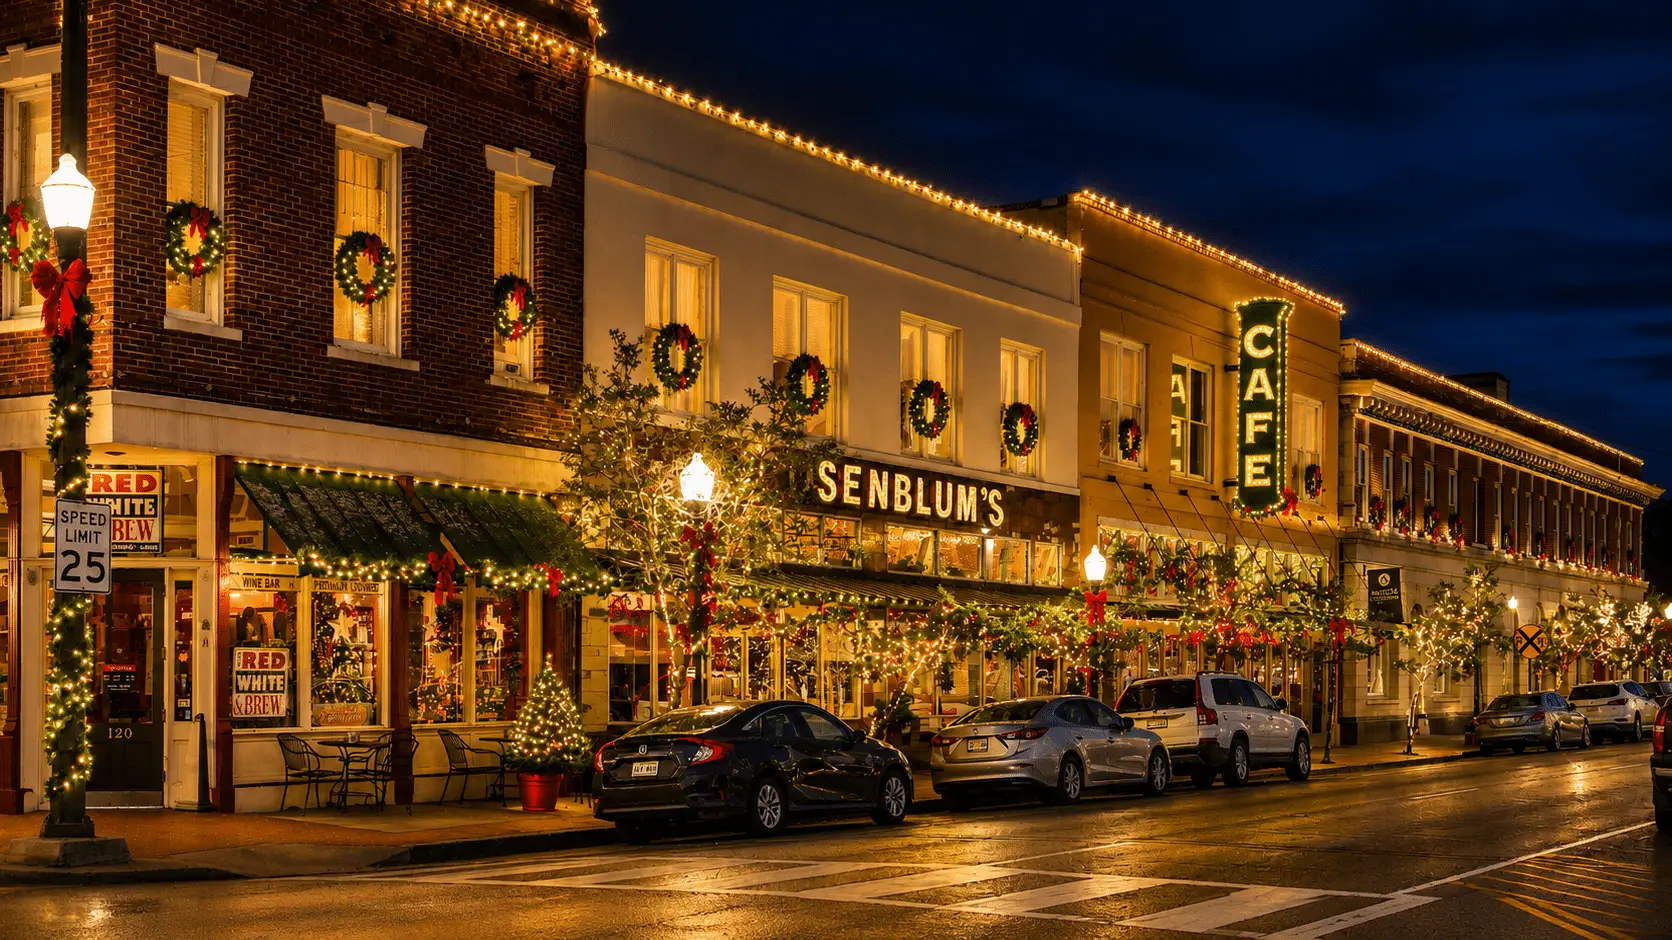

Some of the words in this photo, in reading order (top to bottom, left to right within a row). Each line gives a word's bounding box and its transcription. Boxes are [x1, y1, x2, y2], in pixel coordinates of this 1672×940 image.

[1243, 324, 1274, 487] CAFE
[92, 474, 157, 493] RED
[818, 460, 1005, 527] SENBLUM'S
[86, 498, 155, 516] HITE
[61, 510, 107, 526] SPEED
[65, 529, 102, 544] LIMIT
[60, 550, 105, 583] 25
[242, 577, 262, 588] WINE
[264, 578, 280, 589] BAR
[242, 651, 286, 669] RED
[237, 675, 284, 691] WHITE
[108, 727, 133, 739] 120
